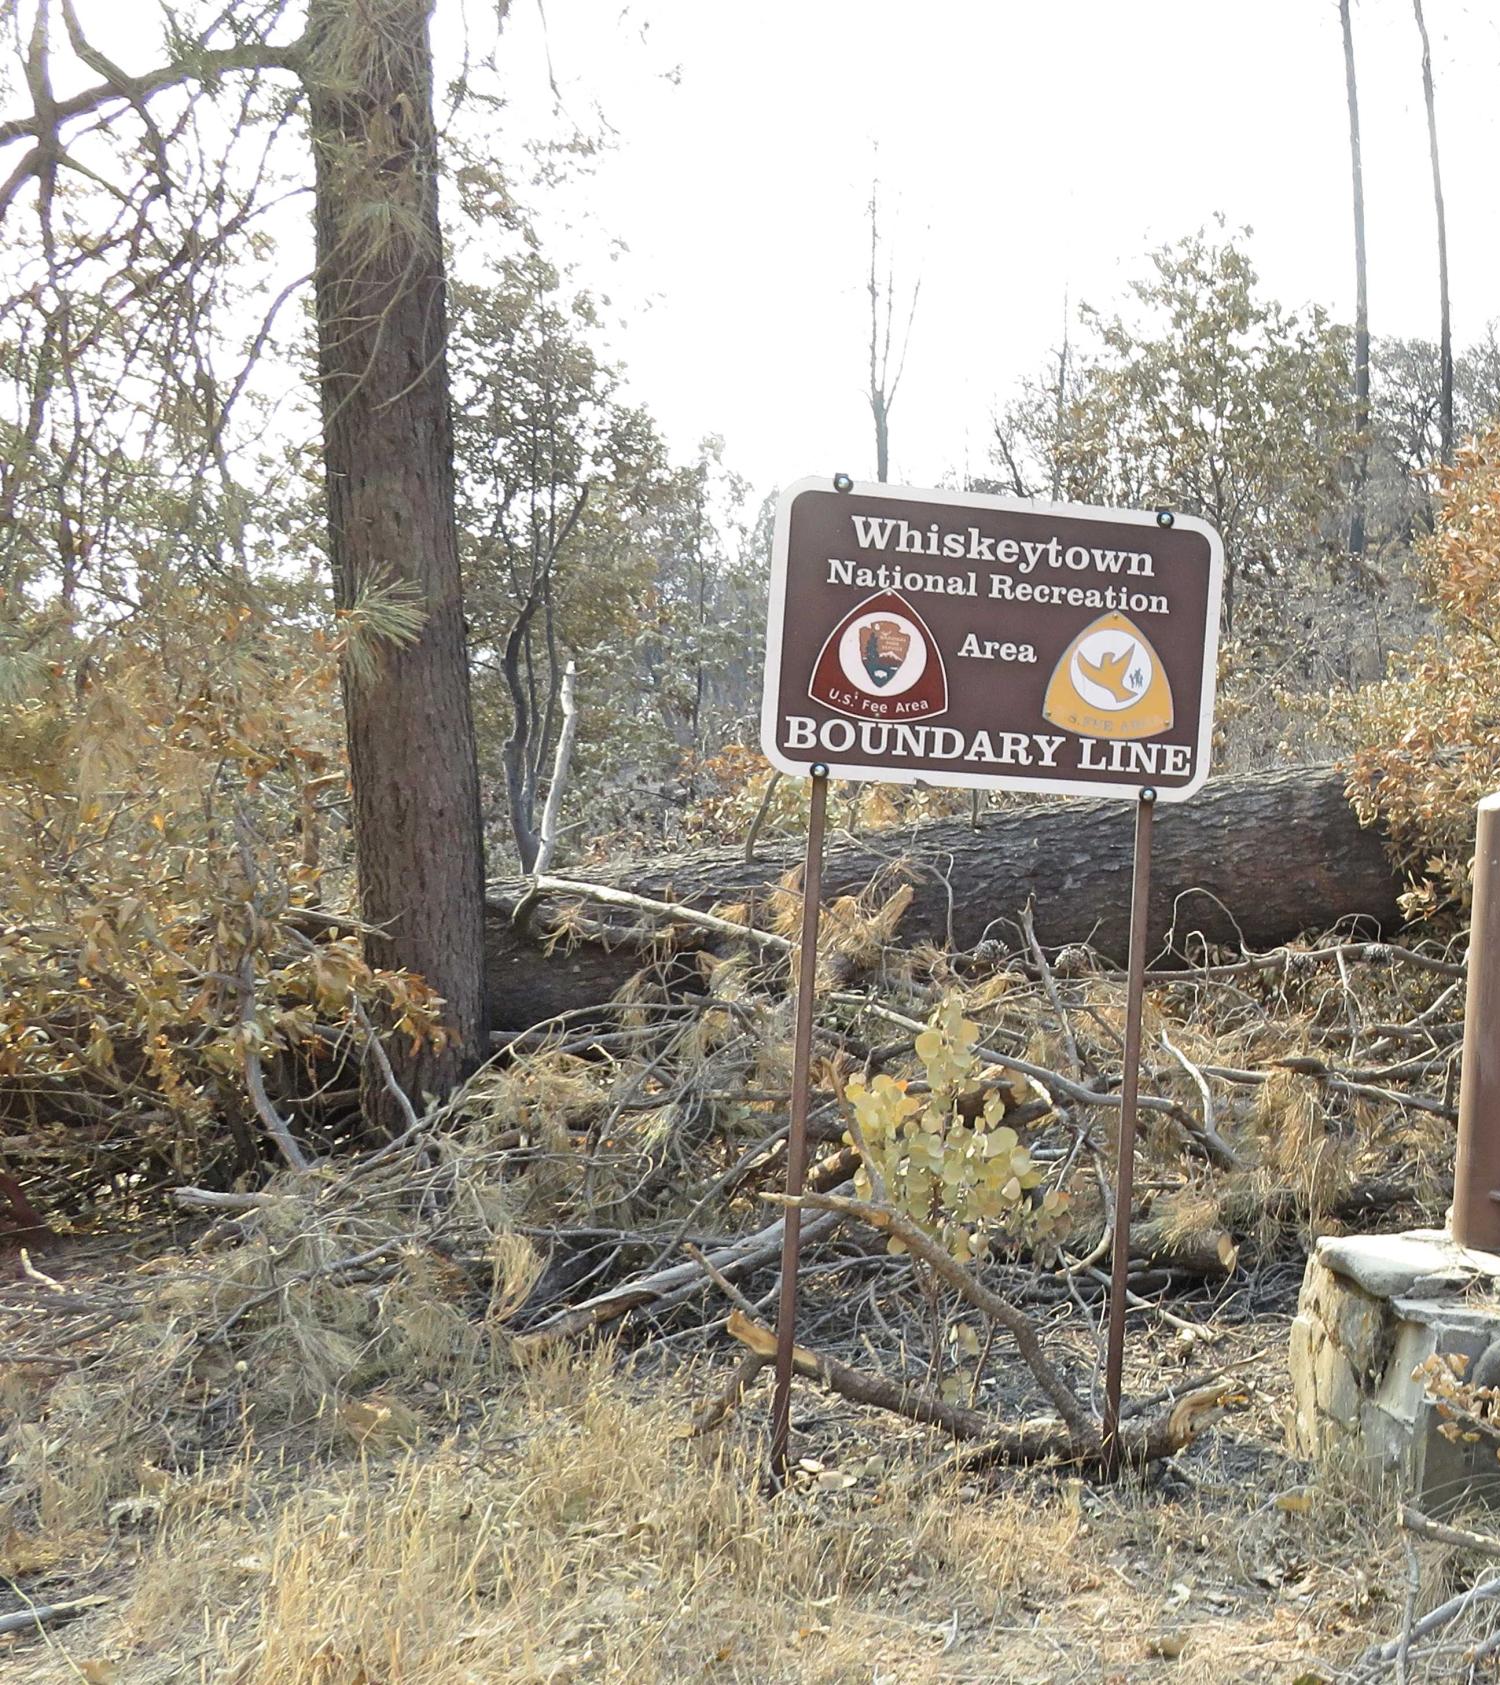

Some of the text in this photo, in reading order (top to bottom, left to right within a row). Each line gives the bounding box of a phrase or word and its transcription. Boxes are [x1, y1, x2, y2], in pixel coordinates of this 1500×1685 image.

[851, 514, 1155, 577] Whiskeytown
[826, 558, 1170, 614] National Recreation
[957, 633, 1038, 663] Area
[862, 699, 888, 713] Fee
[895, 699, 929, 713] Area
[783, 715, 1192, 777] BOUNDARY LINE
